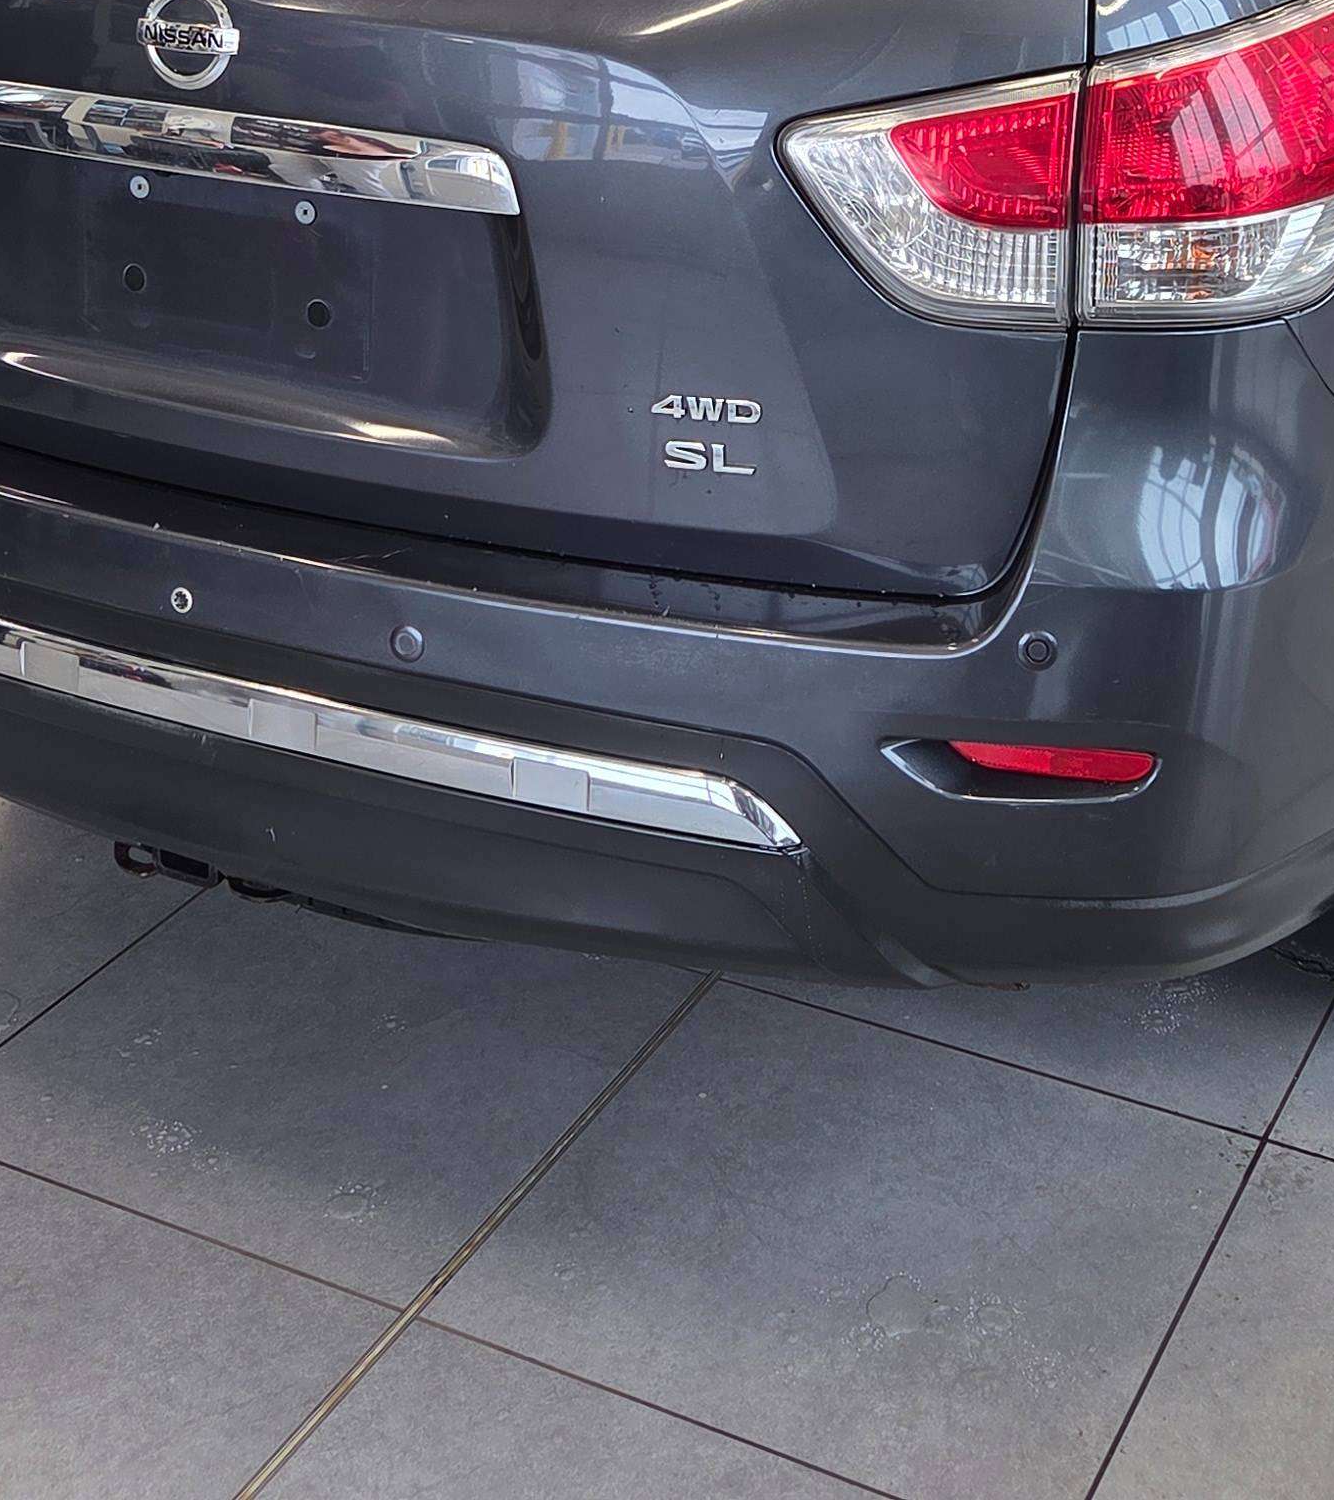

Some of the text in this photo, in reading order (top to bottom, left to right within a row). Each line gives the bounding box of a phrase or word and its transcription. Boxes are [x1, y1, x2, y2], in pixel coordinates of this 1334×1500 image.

[144, 24, 223, 48] NISSAN
[651, 394, 762, 424] 4WD
[664, 440, 756, 476] SL
